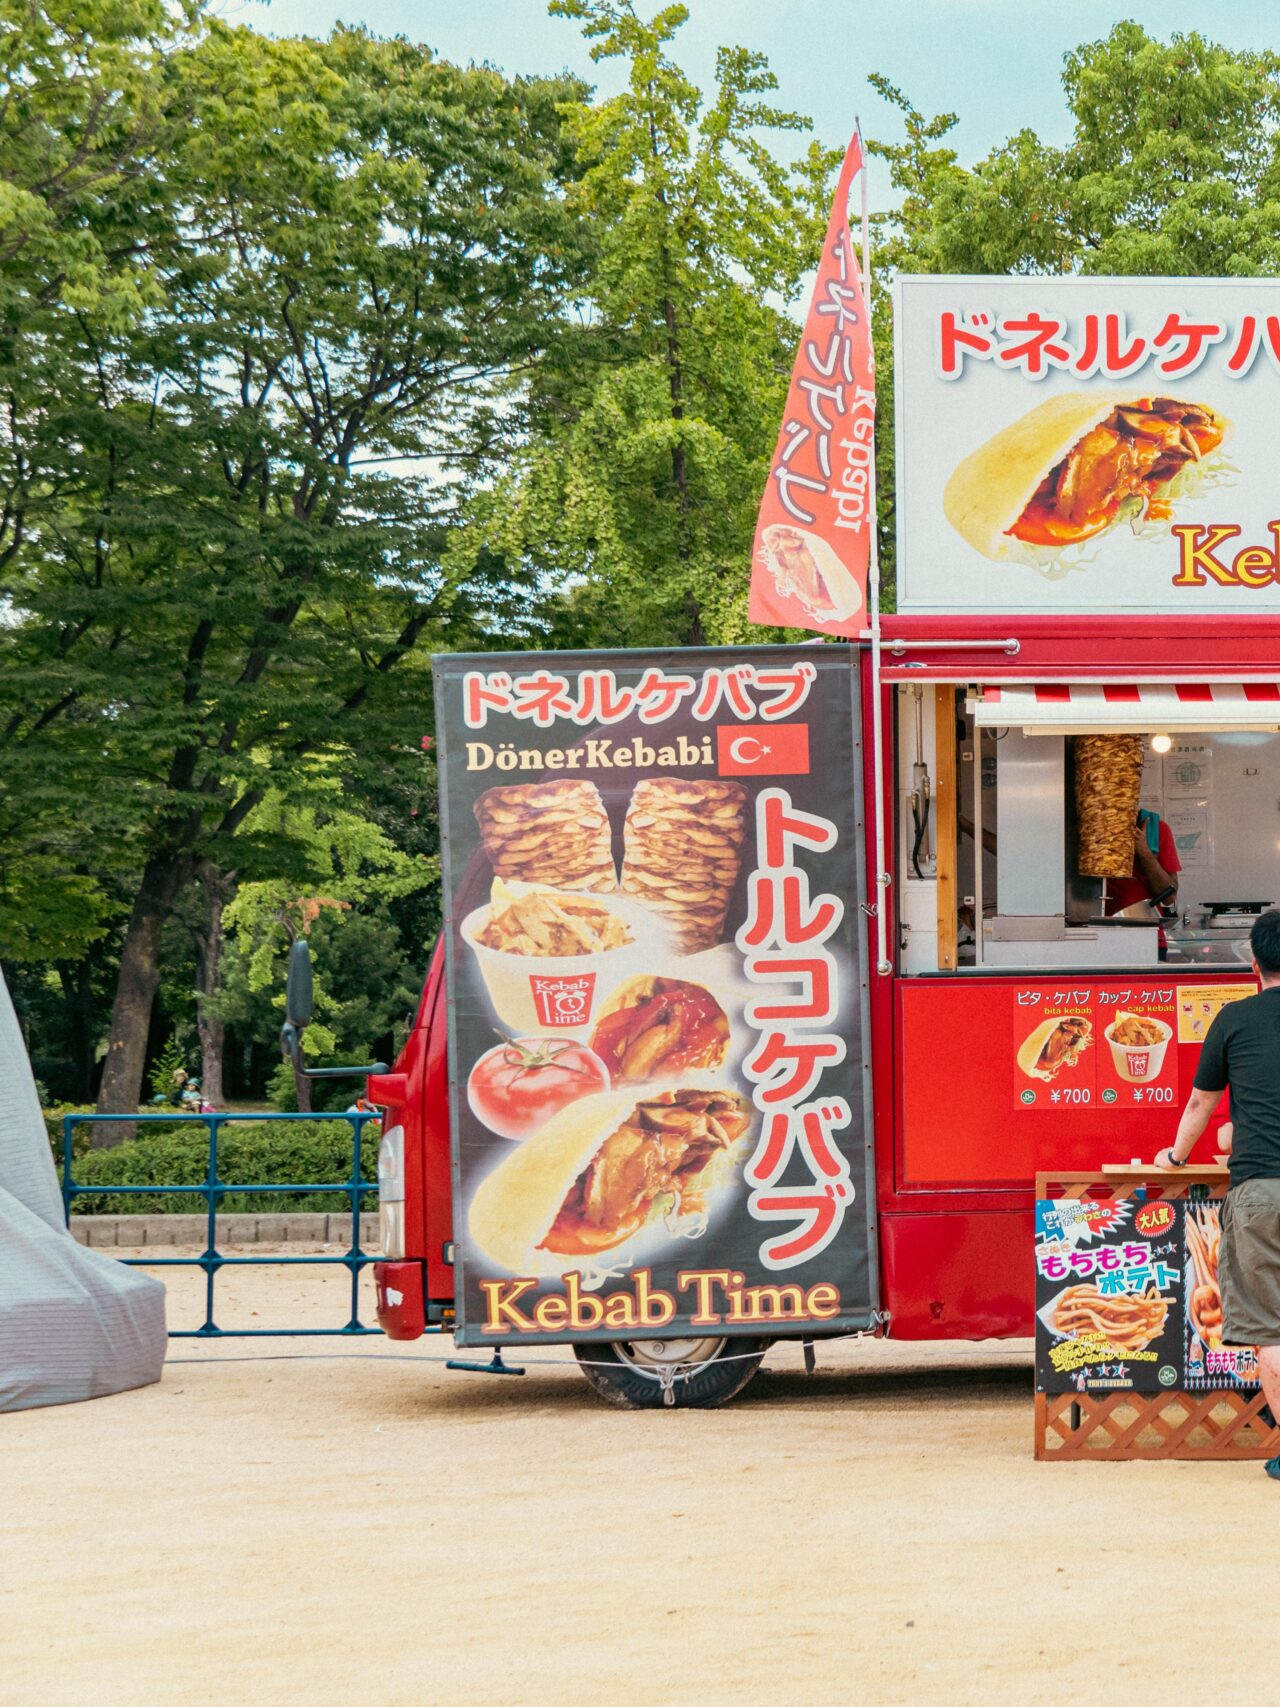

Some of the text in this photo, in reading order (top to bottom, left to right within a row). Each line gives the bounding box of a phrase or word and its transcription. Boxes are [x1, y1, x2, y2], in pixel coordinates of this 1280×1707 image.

[466, 664, 815, 727] ドネルケバブ
[535, 978, 590, 991] Kebab
[1044, 1007, 1092, 1015] bita kebab
[740, 790, 851, 1266] トルコケバブ
[1139, 1208, 1170, 1230] 大人気
[1041, 1244, 1147, 1278] もちもち
[1099, 1263, 1178, 1294] ポテト
[482, 1270, 840, 1336] Kebab Time
